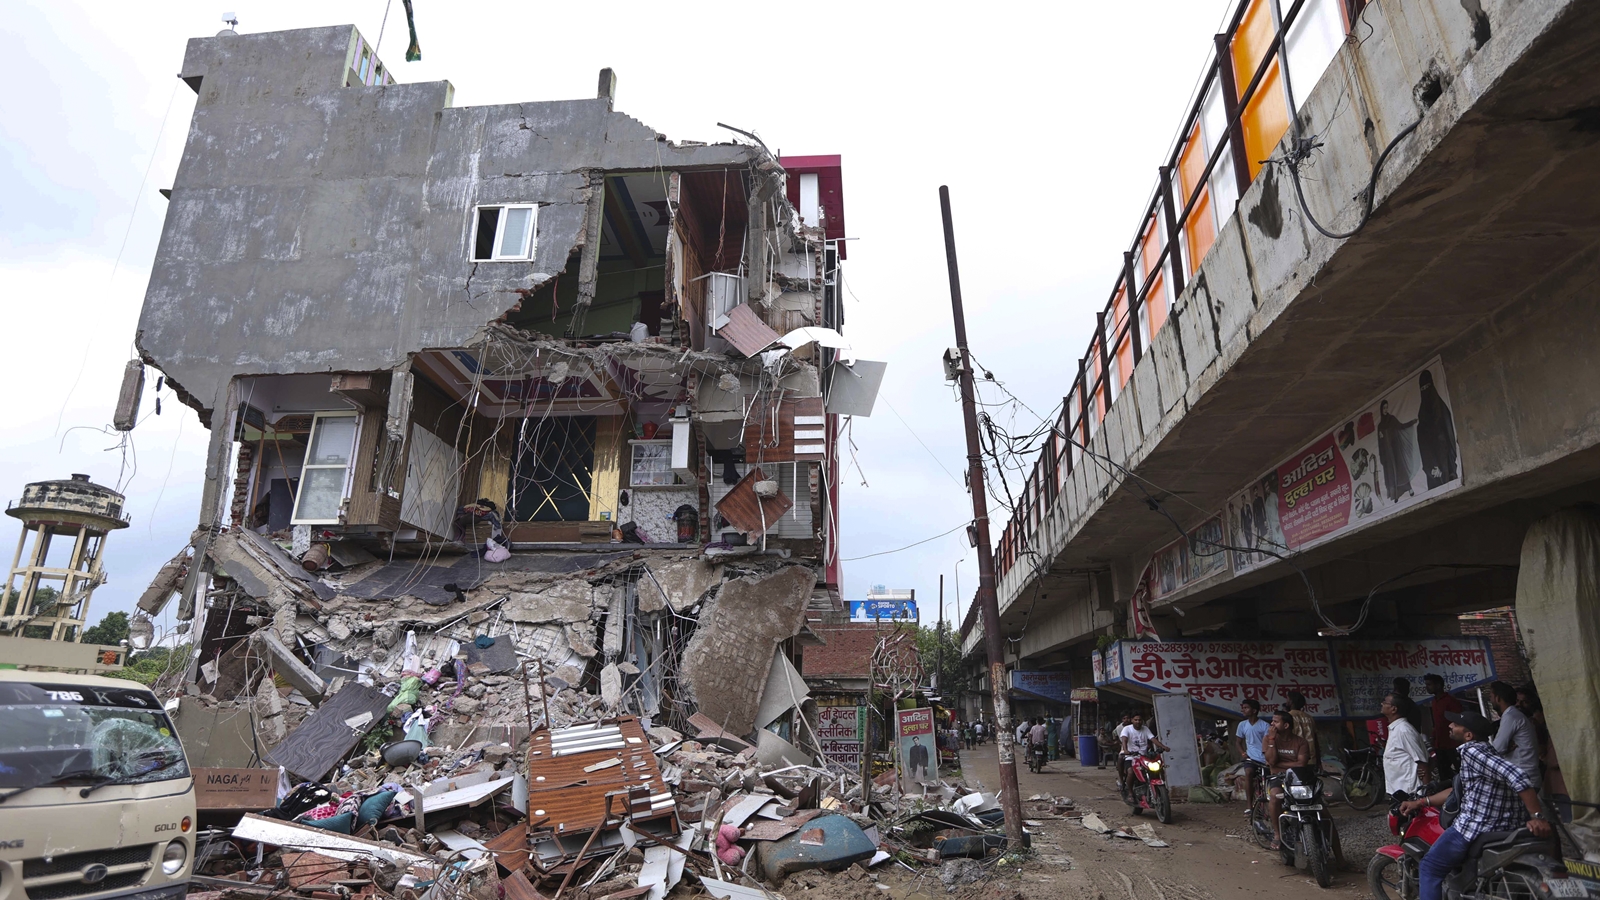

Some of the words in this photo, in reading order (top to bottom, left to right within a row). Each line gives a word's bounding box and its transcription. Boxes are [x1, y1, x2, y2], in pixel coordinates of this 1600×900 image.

[1282, 445, 1335, 490] आदिल
[1284, 478, 1315, 508] दुल्हा
[1314, 465, 1336, 486] घर
[1284, 648, 1328, 664] नकाब
[1429, 645, 1487, 667] कलेक्शन
[46, 690, 84, 701] 786
[1185, 683, 1239, 702] दुल्हा
[901, 712, 929, 723] आदिल
[206, 774, 238, 785] NAGA
[154, 823, 177, 833] GOLD
[1564, 859, 1593, 879] RINKU
